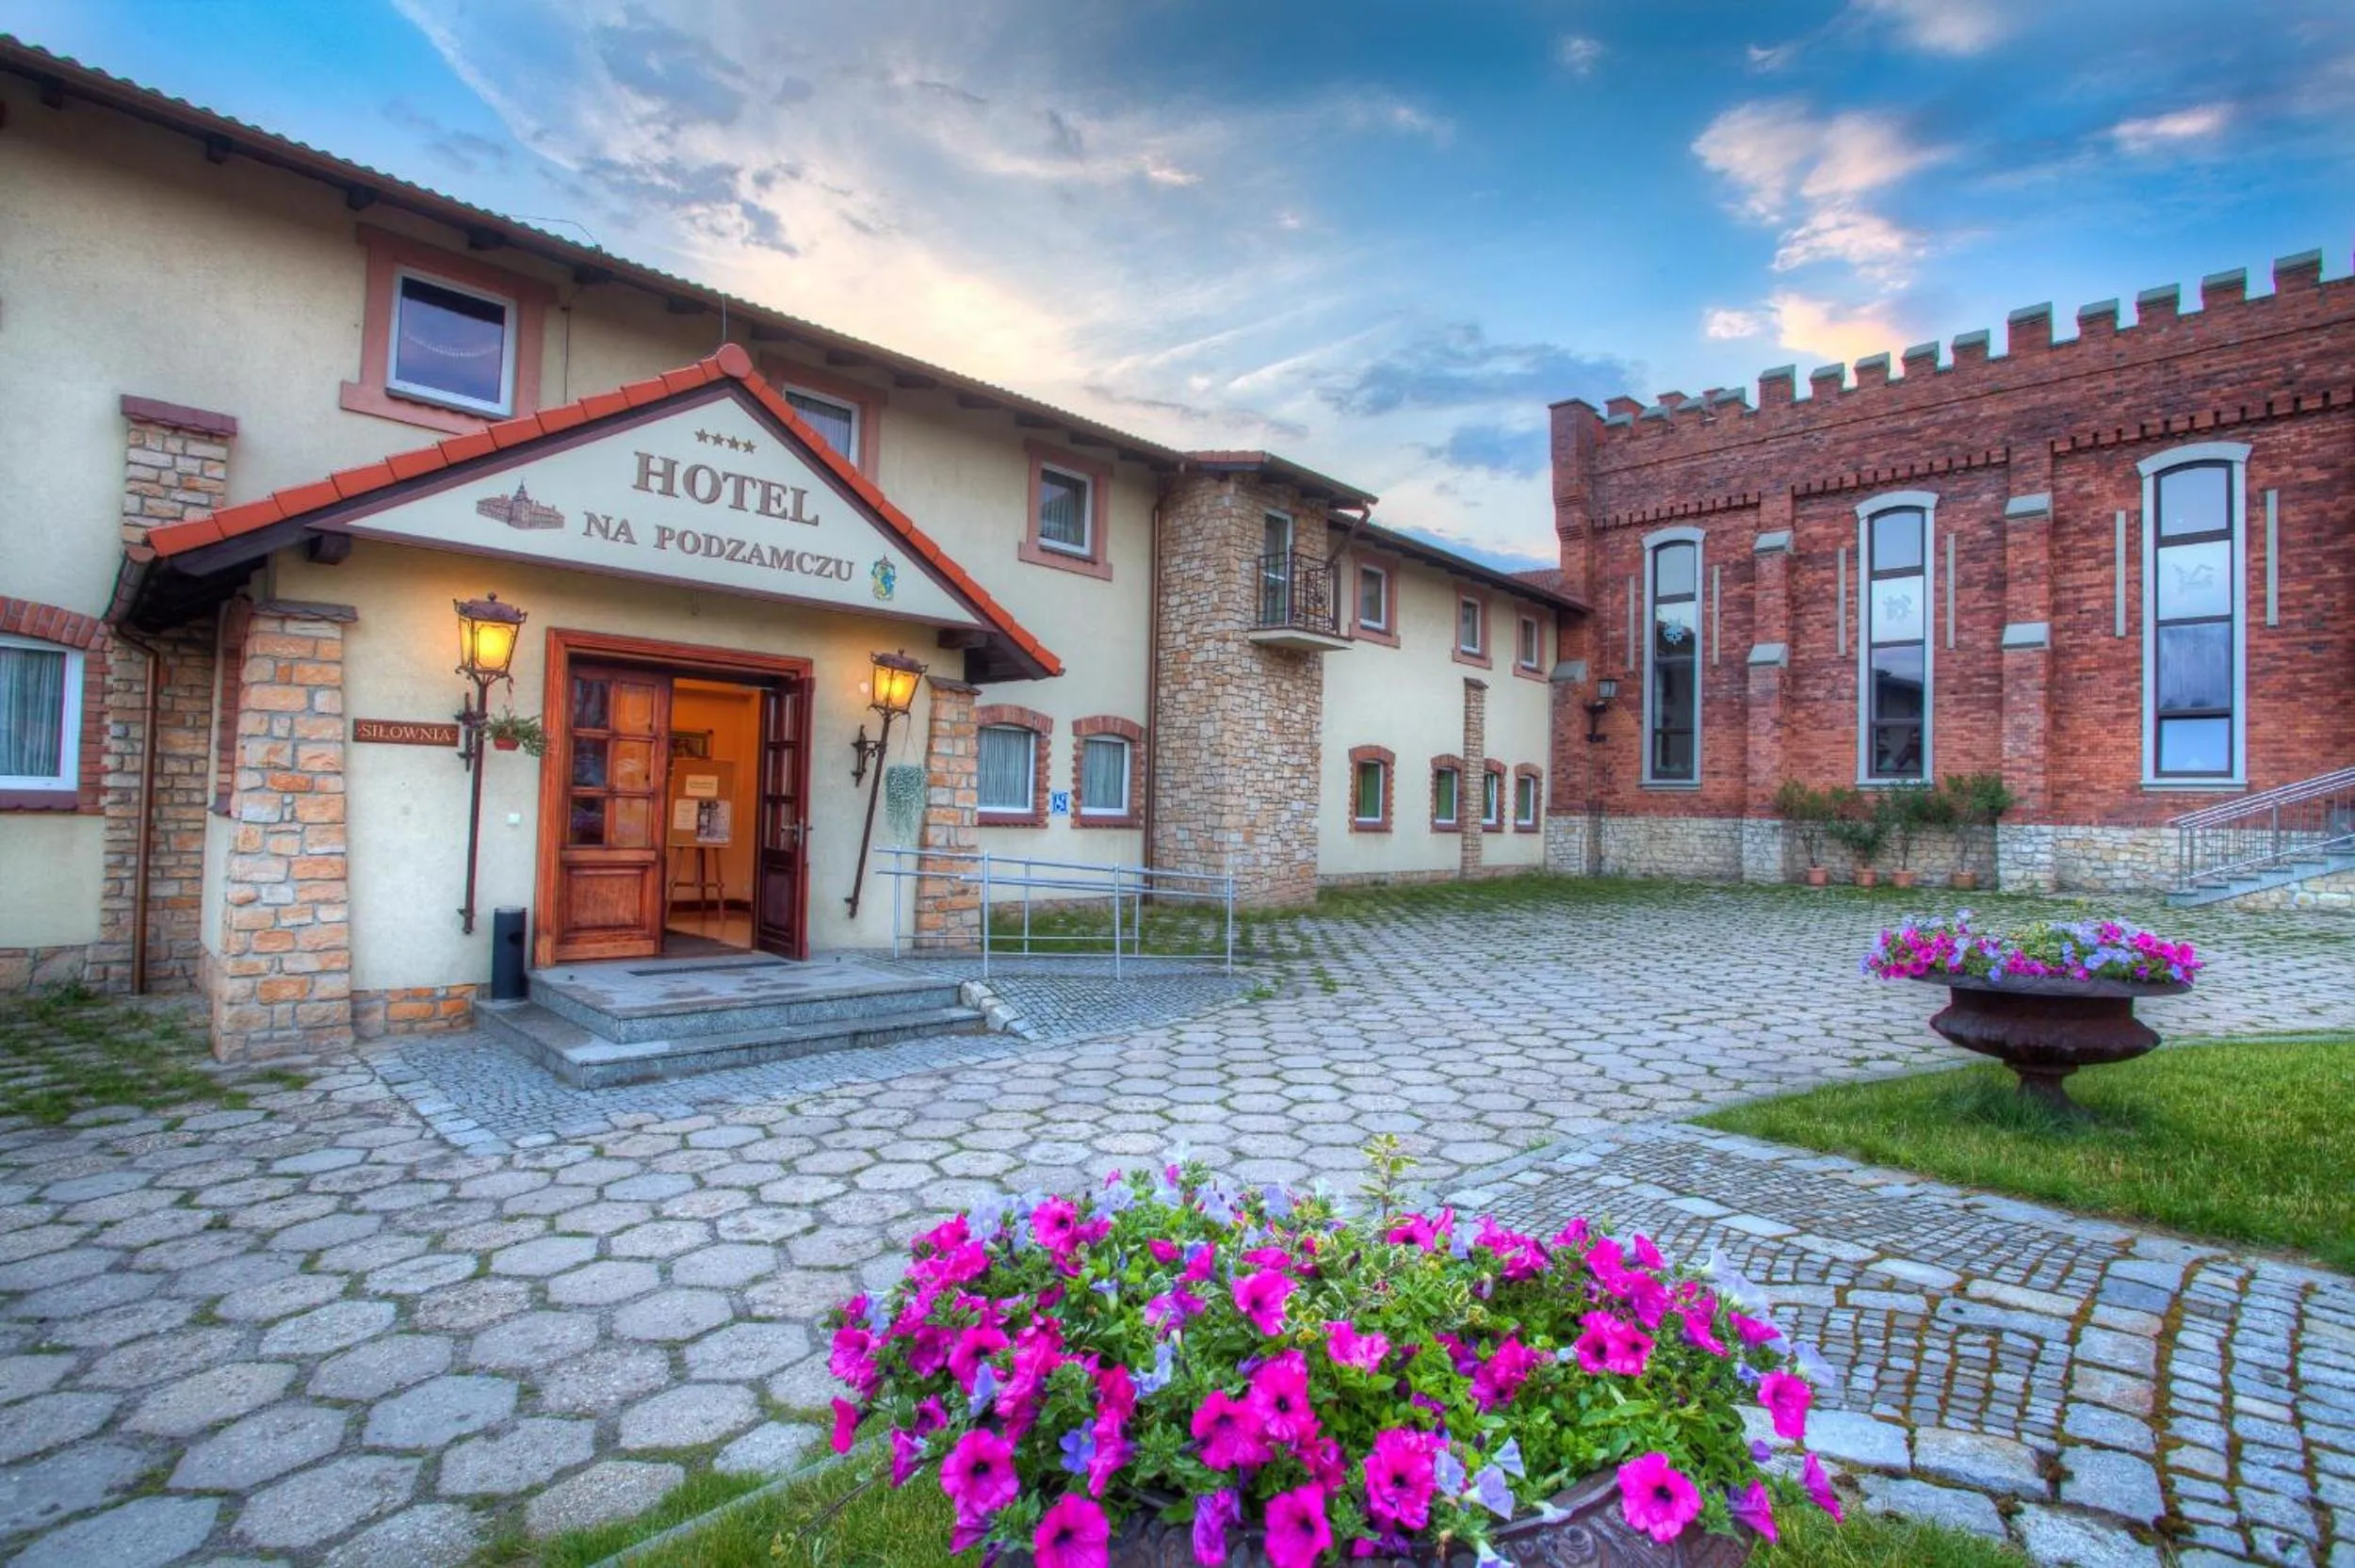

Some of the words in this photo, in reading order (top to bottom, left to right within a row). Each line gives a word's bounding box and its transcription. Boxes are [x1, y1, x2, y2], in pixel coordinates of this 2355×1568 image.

[632, 451, 820, 526] HOTEL
[582, 511, 637, 544] NA
[654, 525, 854, 581] PODZAMCZU
